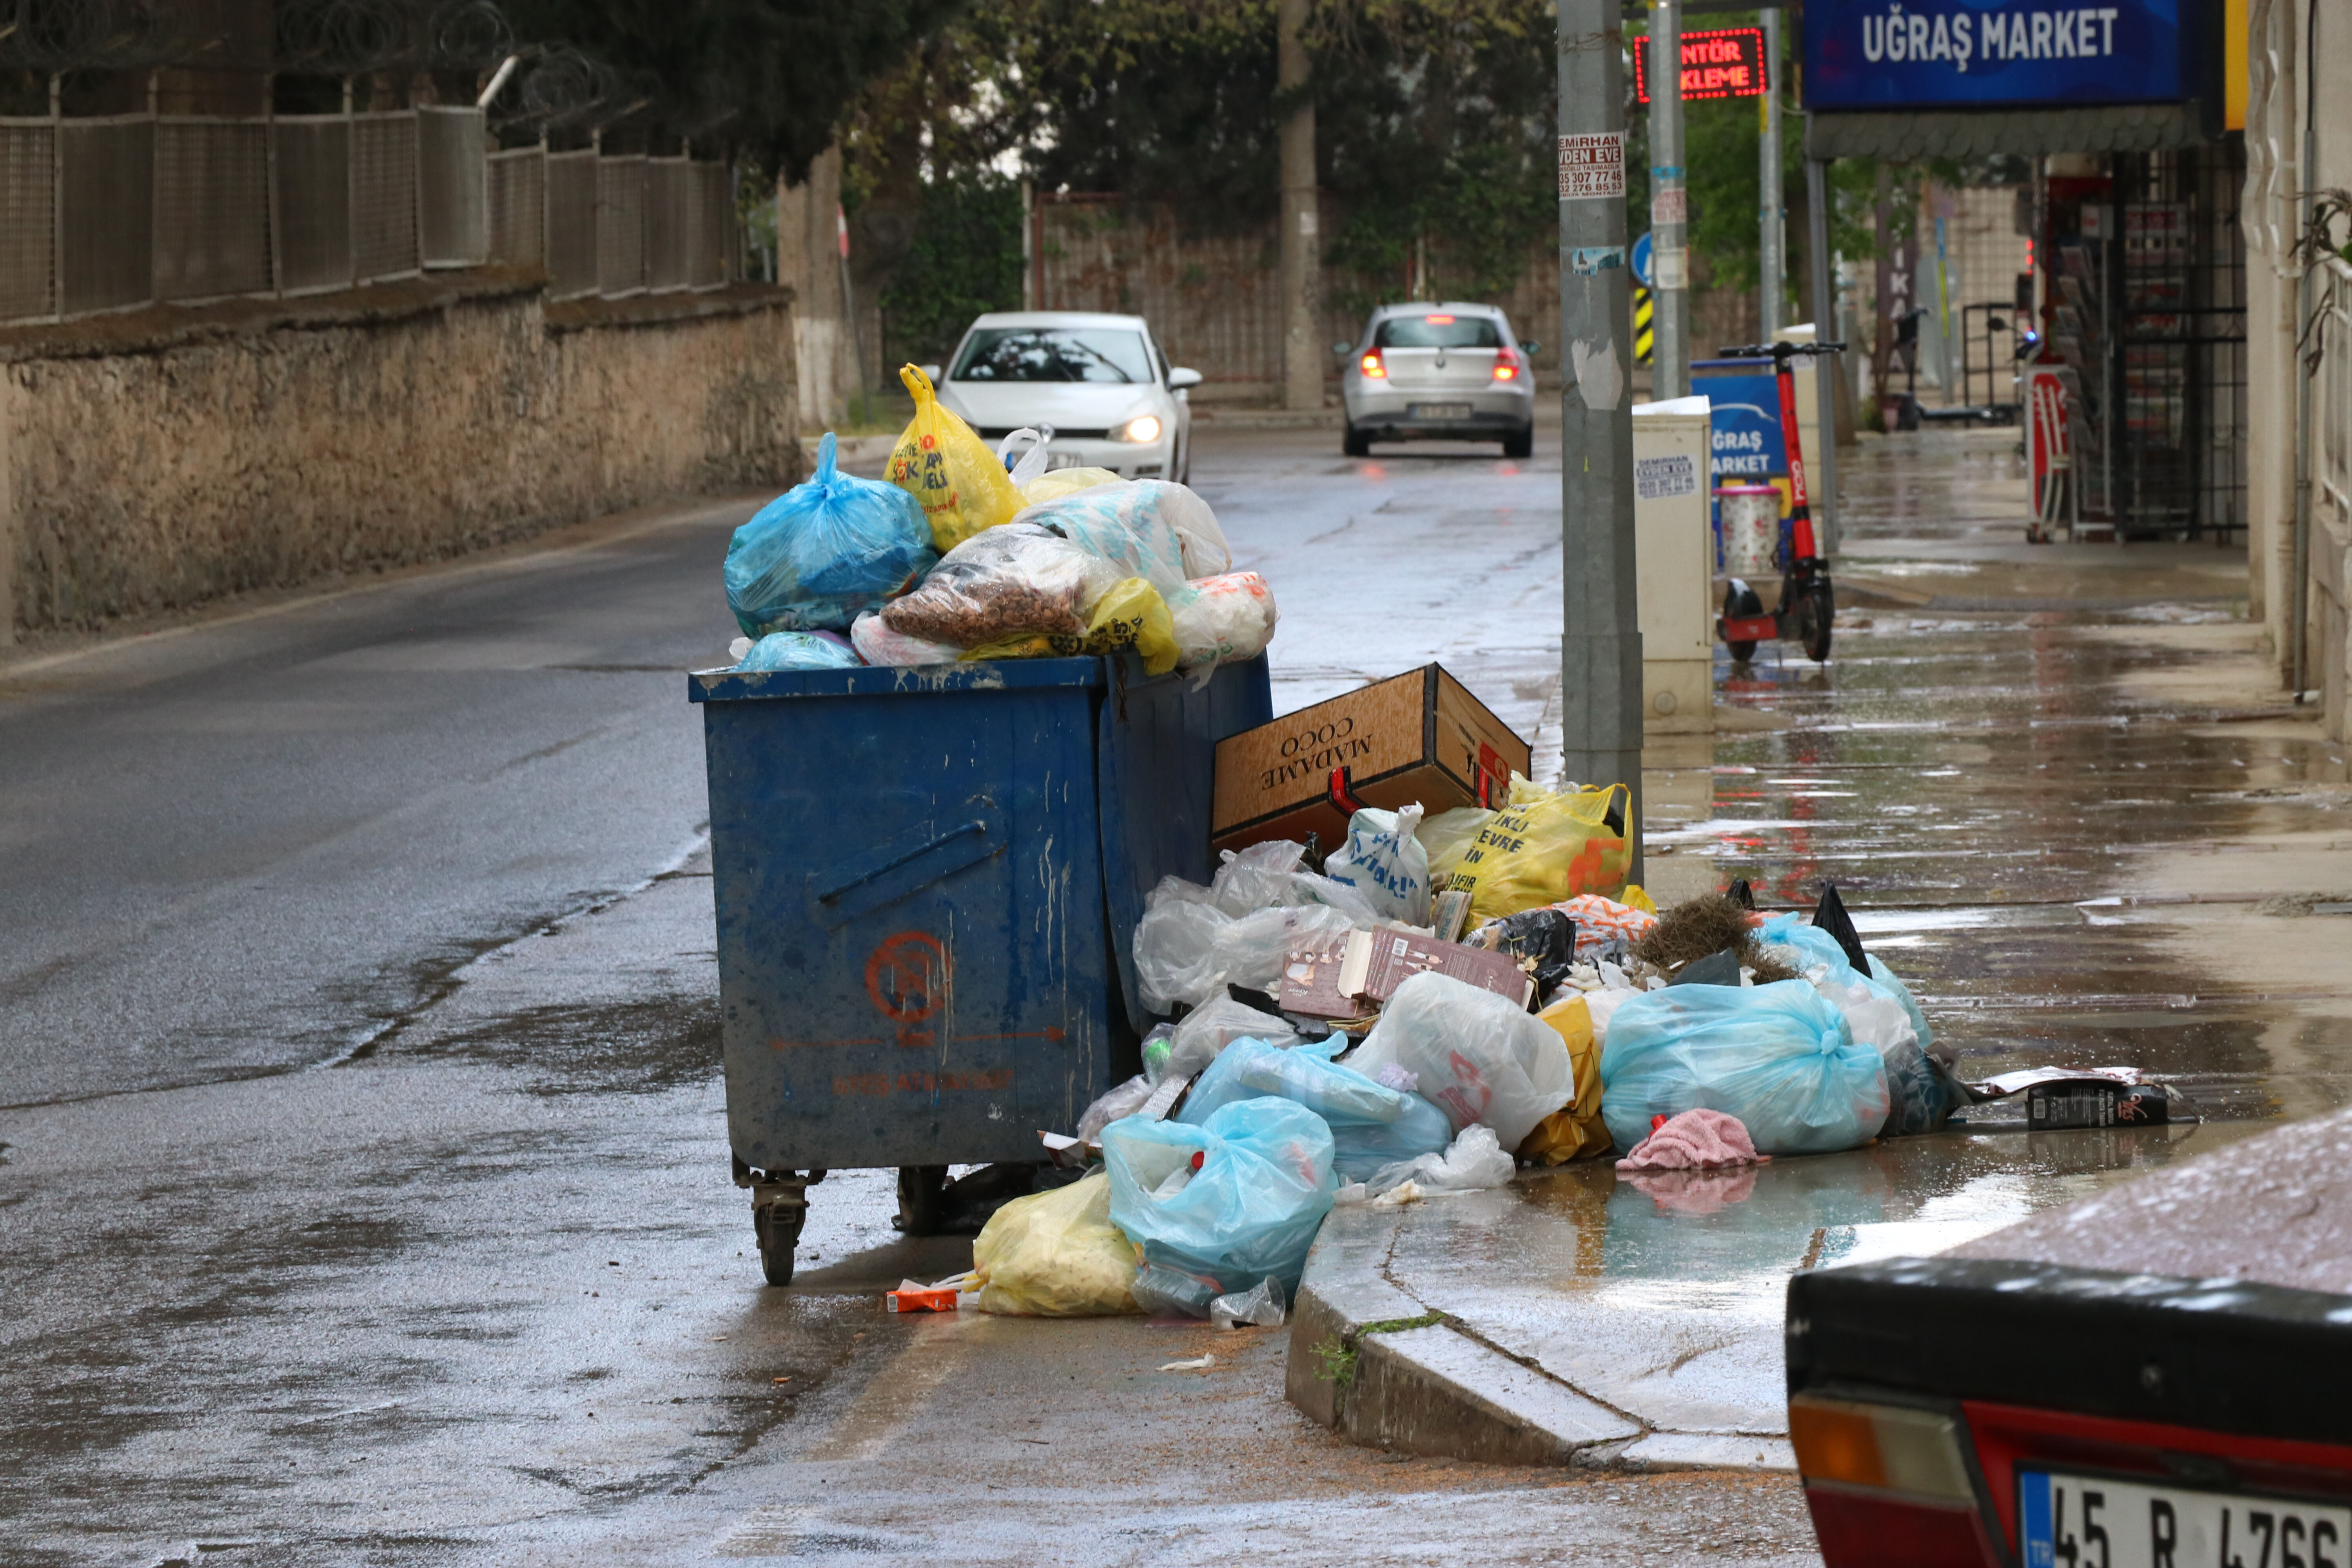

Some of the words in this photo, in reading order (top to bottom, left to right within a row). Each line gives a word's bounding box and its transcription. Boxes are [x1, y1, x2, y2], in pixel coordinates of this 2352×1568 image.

[1681, 38, 1742, 64] NTÖR
[1863, 4, 1973, 73] UĞRAŞ
[1982, 8, 2118, 60] MARKET
[1680, 65, 1749, 91] KLEME
[1559, 136, 1619, 148] EMİRHAN
[1559, 149, 1590, 164] VDEN
[1595, 147, 1619, 162] EVE
[1559, 173, 1569, 183] 35
[1572, 172, 1591, 183] 307
[1595, 171, 1609, 181] 77
[1612, 170, 1621, 181] 46
[1712, 429, 1762, 452] ĞRAŞ
[1711, 454, 1770, 472] ARKET
[1281, 717, 1354, 757] COCO
[1261, 733, 1372, 790] MADAME
[1475, 829, 1524, 853] EVRE
[2055, 1487, 2110, 1568] 45
[2149, 1498, 2177, 1568] R
